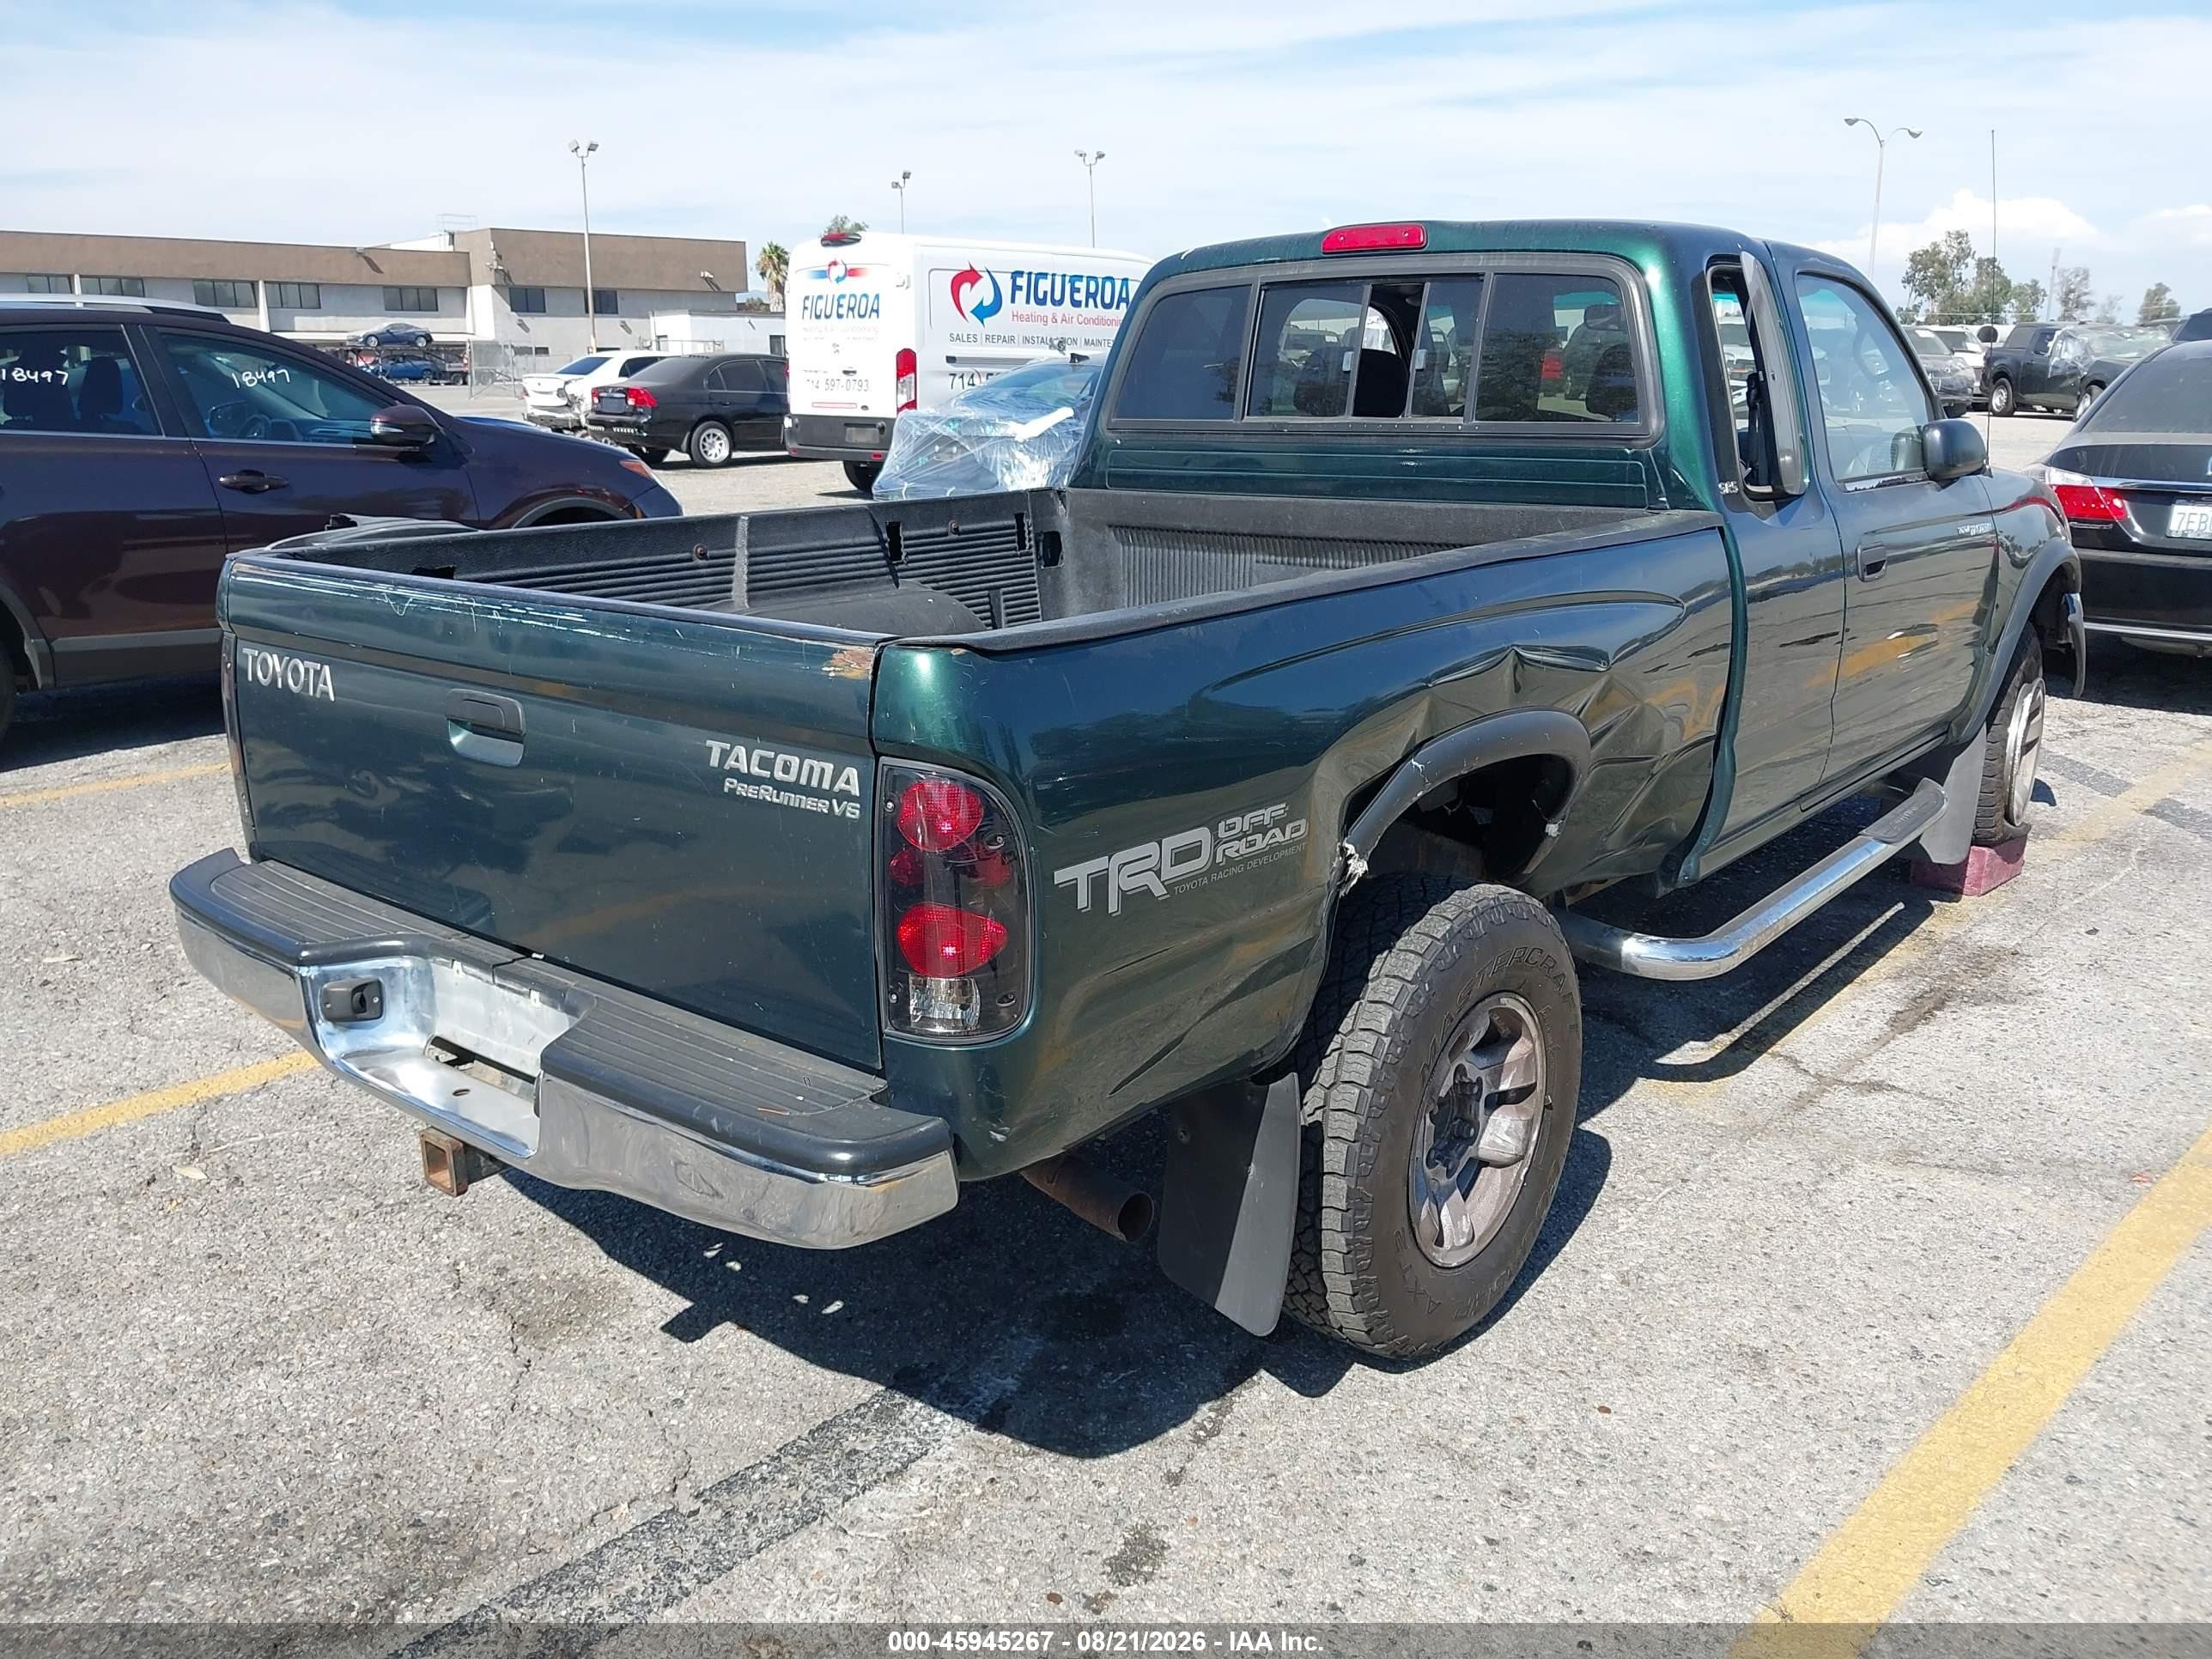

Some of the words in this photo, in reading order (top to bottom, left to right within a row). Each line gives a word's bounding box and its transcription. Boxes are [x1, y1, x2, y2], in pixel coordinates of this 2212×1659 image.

[802, 293, 880, 320] FIGUEROA
[1010, 270, 1129, 310] FIGUEROA
[1012, 310, 1048, 326] Heating
[1051, 313, 1058, 324] &
[1060, 313, 1074, 325] Air
[949, 332, 978, 343] SALES
[985, 334, 1016, 345] REPAIR
[1, 368, 69, 386] 18497
[232, 368, 290, 388] 18497
[241, 647, 336, 702] TOYOTA
[705, 739, 860, 797] TACOMA
[1218, 802, 1290, 840] OFF
[1215, 817, 1310, 866] ROAD
[1054, 826, 1213, 917] TRD
[1174, 878, 1208, 896] TOYOTA
[1211, 864, 1244, 884] RACING
[1247, 842, 1307, 871] DEVELOPMENT
